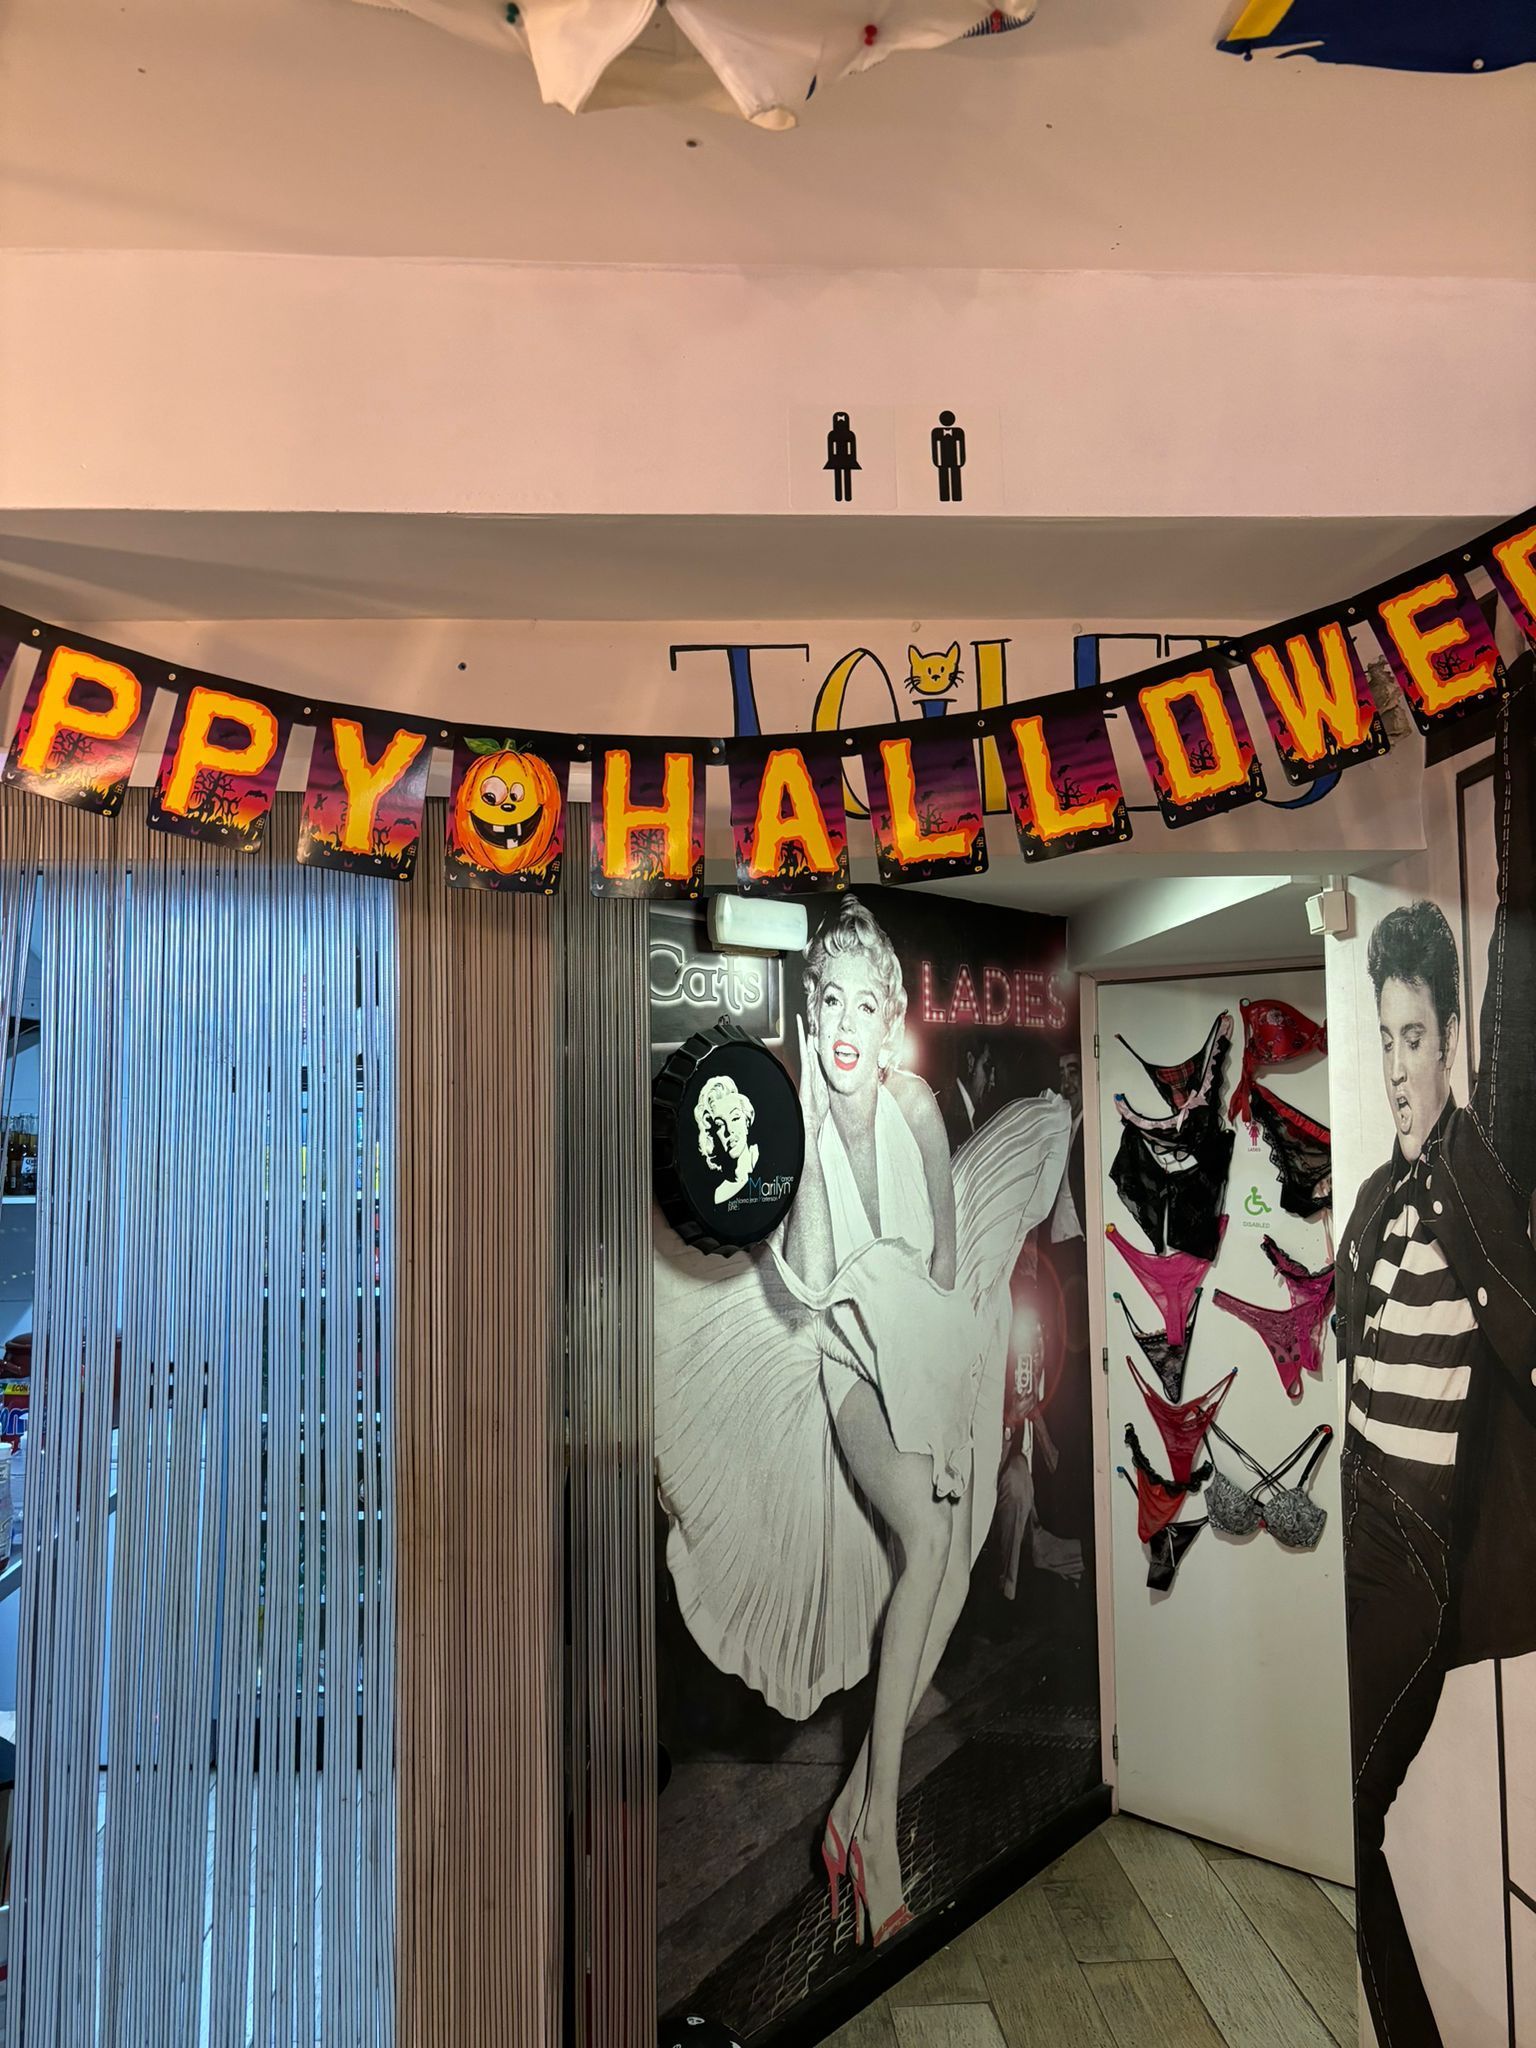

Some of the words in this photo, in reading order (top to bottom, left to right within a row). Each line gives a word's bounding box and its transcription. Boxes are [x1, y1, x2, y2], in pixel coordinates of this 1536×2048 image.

[650, 943, 761, 1010] Cats
[922, 960, 1067, 1029] LADIES
[749, 1177, 791, 1200] Marilyn
[1243, 1221, 1270, 1229] DISABLED
